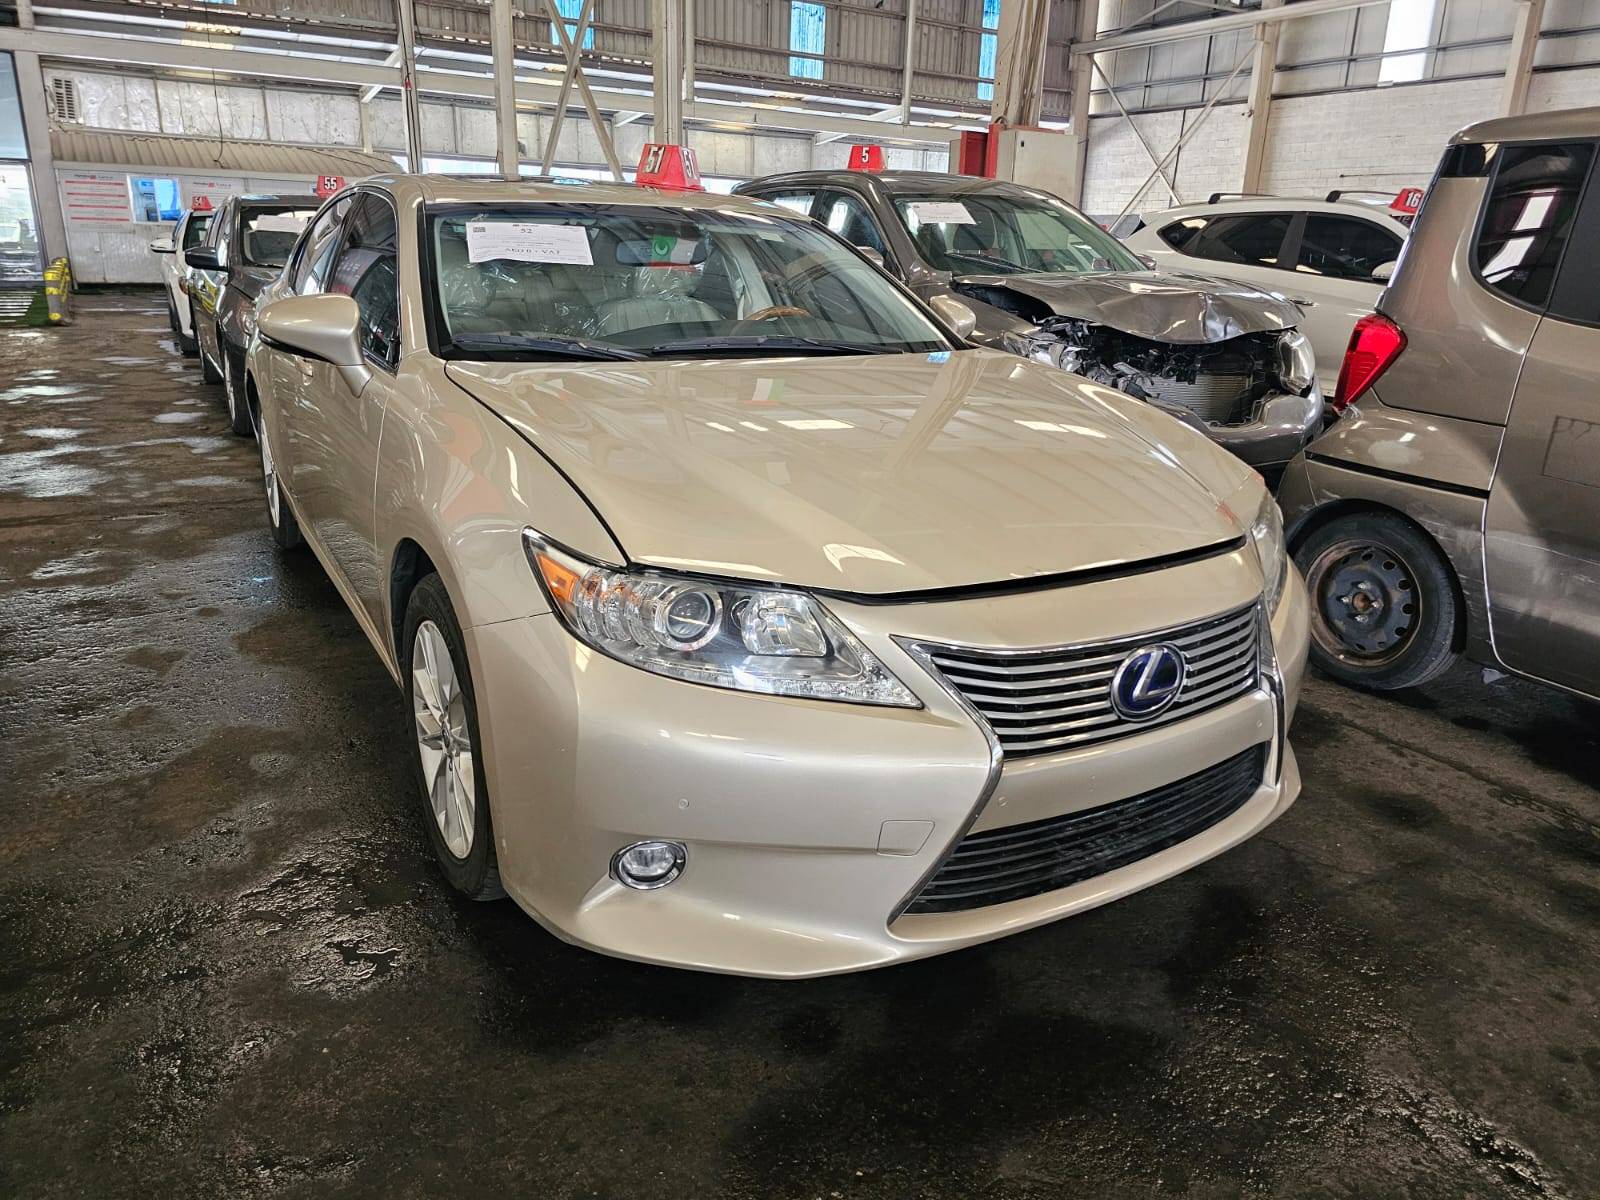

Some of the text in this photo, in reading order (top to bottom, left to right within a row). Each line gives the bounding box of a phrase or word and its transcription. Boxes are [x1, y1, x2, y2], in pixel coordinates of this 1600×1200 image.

[644, 145, 665, 174] 51
[862, 146, 870, 163] 5
[324, 176, 337, 190] 55
[1406, 191, 1421, 208] 16
